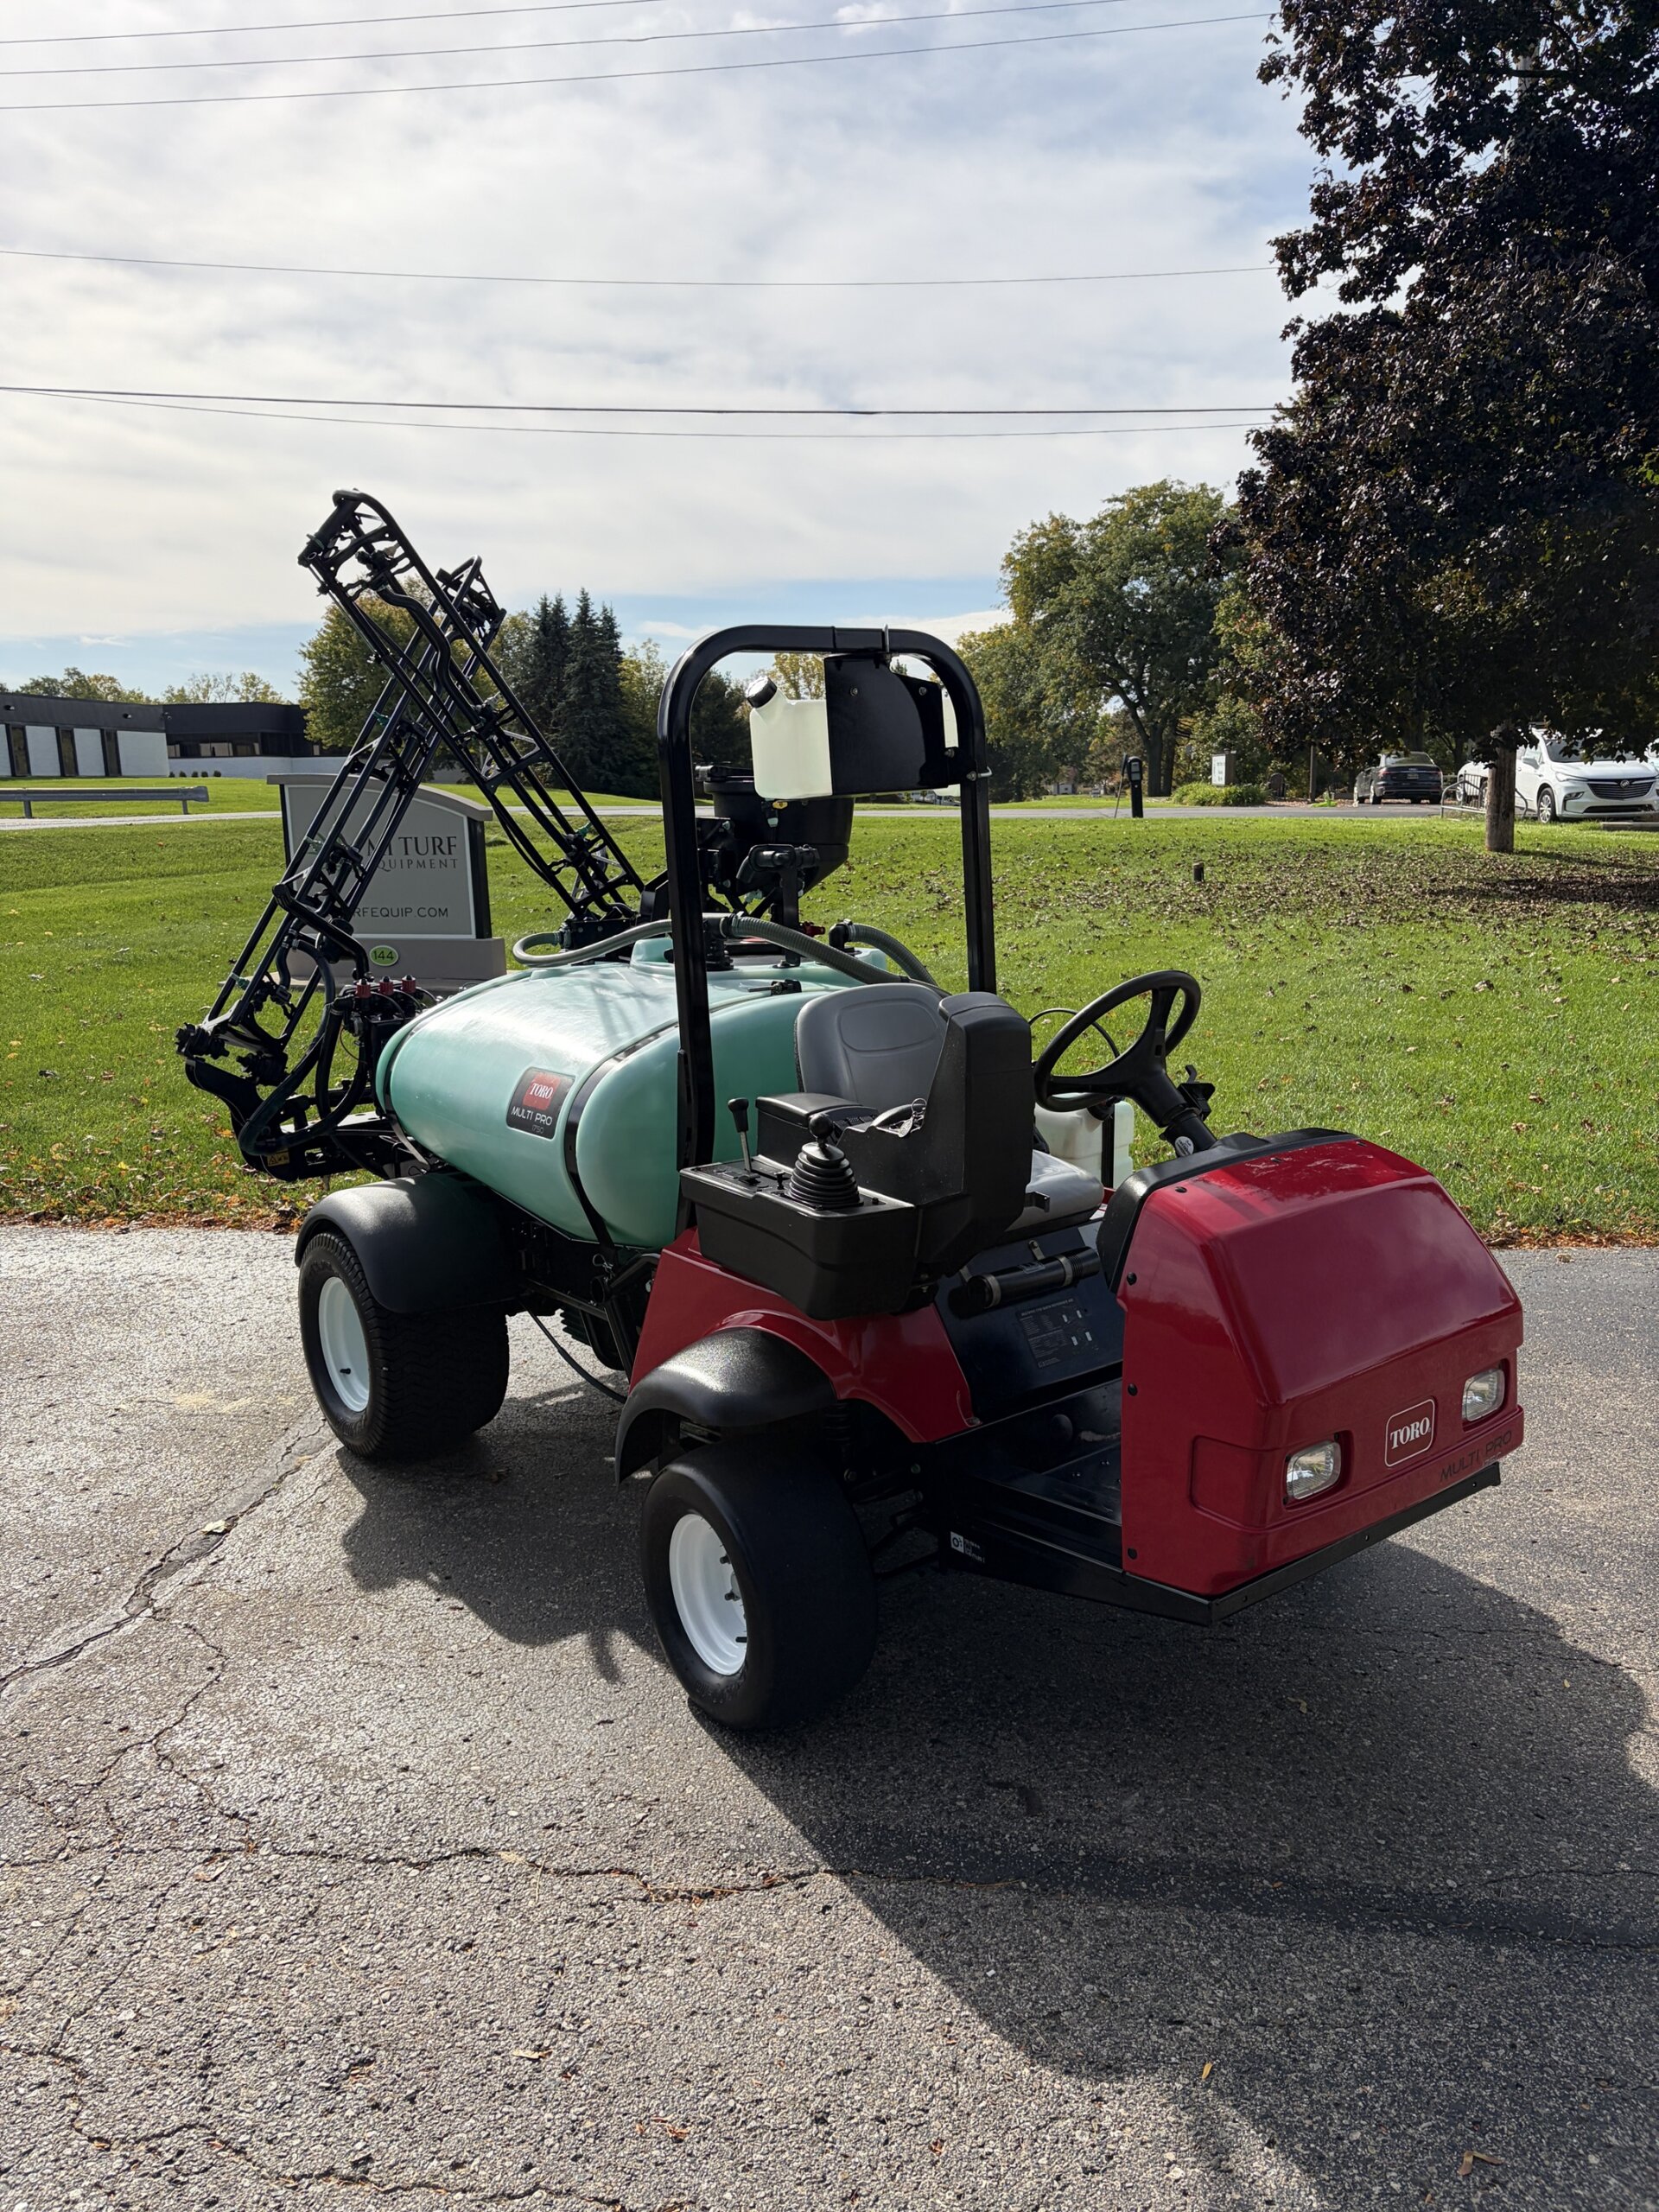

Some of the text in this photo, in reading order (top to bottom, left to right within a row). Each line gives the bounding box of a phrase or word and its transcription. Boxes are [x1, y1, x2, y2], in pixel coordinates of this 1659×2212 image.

[398, 836, 457, 855] TURF
[378, 858, 458, 872] QUIPMENT
[353, 906, 448, 918] RFEQUIP.COM
[372, 950, 395, 961] 144
[530, 1083, 554, 1099] TORO
[511, 1106, 552, 1126] MULTI PRO
[1389, 1416, 1431, 1450] TORO
[1440, 1449, 1479, 1482] MULTI
[1485, 1430, 1512, 1454] PRO
